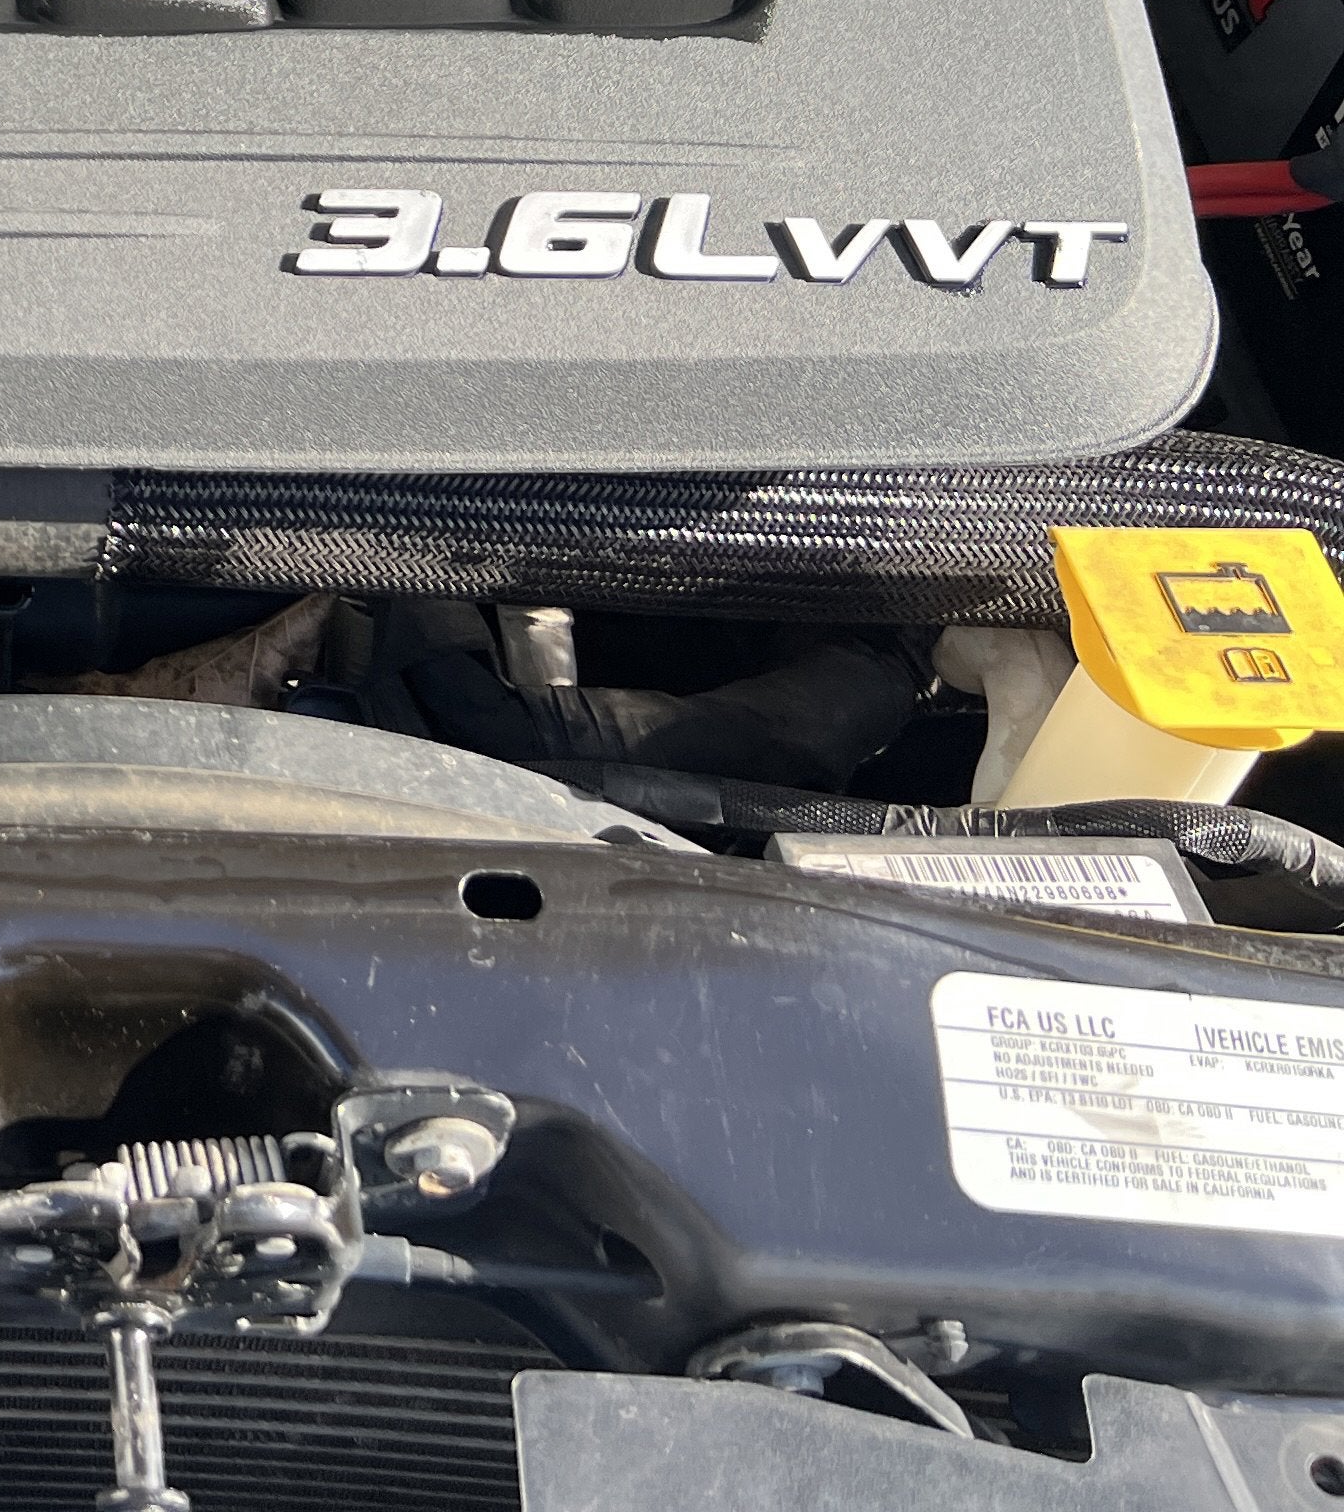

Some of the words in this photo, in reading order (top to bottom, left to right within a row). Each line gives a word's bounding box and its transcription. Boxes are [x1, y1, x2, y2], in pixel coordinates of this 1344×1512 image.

[287, 188, 780, 283] 3.6L
[774, 217, 1129, 289] VVT
[987, 1005, 1030, 1031] FCA
[1037, 1010, 1068, 1035] US
[1075, 1014, 1116, 1039] LLC
[991, 1036, 1037, 1051] GROUP:
[1202, 1026, 1289, 1056] VEHICLE
[1295, 1035, 1344, 1061] EMIS
[993, 1051, 1011, 1064] NO
[1015, 1053, 1103, 1073] ADJUSTMENTS
[1107, 1062, 1154, 1077] NEEDED
[1189, 1054, 1225, 1070] EVAP:
[1000, 1087, 1025, 1102] U.S.
[1029, 1089, 1057, 1104] EPA:
[1146, 1100, 1173, 1115] OBD:
[1178, 1103, 1194, 1117] CA
[1197, 1105, 1221, 1119] OBD
[1249, 1109, 1283, 1125] FUEL:
[1286, 1113, 1344, 1130] GASOLINE
[1006, 1137, 1027, 1151] CA:
[1047, 1140, 1076, 1155] OBD:
[1080, 1143, 1096, 1157] CA
[1101, 1145, 1125, 1159] OBD
[1154, 1150, 1189, 1165] FUEL:
[1193, 1153, 1311, 1176] GASOLINE/ETHANOL
[1009, 1152, 1037, 1166] THIS
[1041, 1154, 1092, 1171] VEHICLE
[1096, 1159, 1163, 1177] CONFORMS
[1169, 1165, 1183, 1178] TO
[1188, 1167, 1240, 1184] FEDERAL
[1245, 1172, 1327, 1191] REGULATIONS
[1010, 1167, 1036, 1181] AND
[1040, 1169, 1052, 1182] IS
[1056, 1170, 1120, 1188] CERTIFIED
[1124, 1176, 1149, 1191] FOR
[1152, 1179, 1182, 1193] SALE
[1186, 1181, 1199, 1194] IN
[1203, 1182, 1275, 1201] CALIFORNIA
